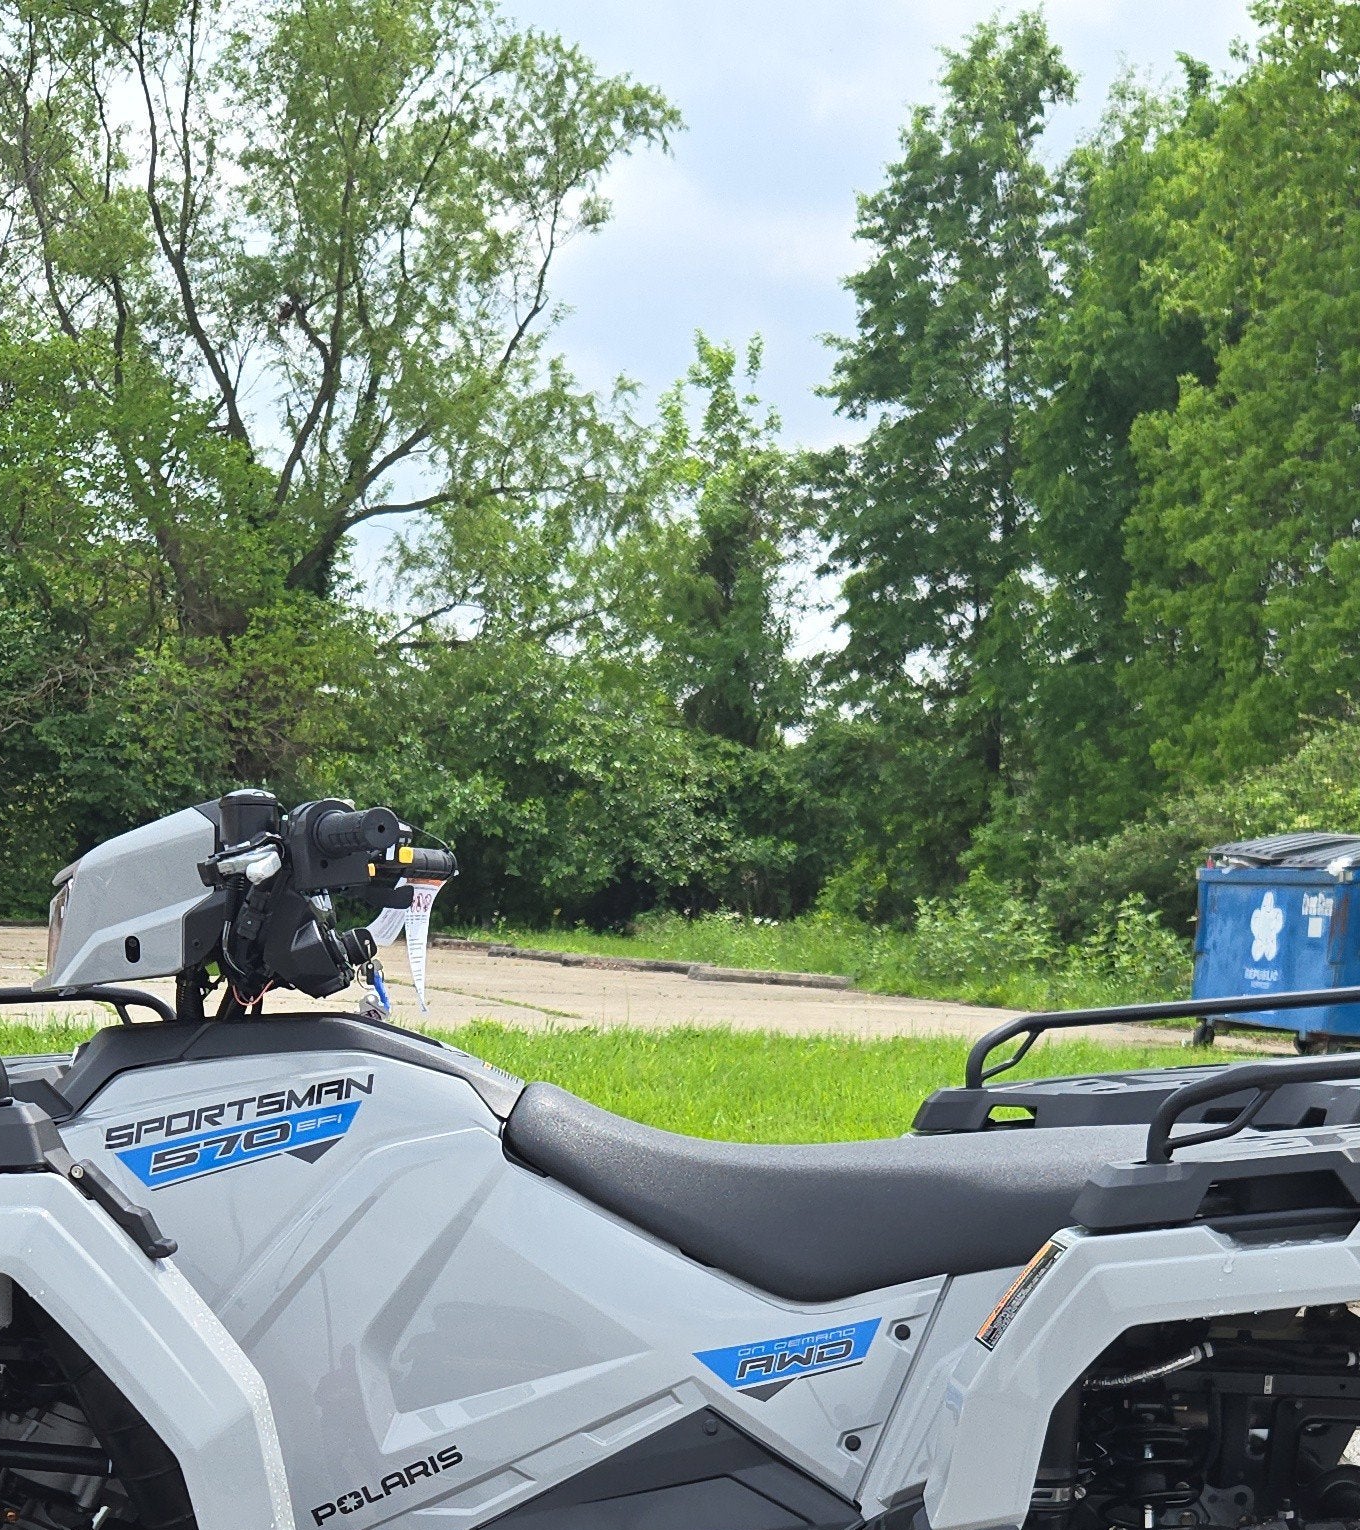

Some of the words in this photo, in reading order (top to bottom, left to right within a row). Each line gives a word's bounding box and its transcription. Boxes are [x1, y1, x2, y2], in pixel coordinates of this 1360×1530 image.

[104, 1073, 375, 1150] SPORTSMAN
[148, 1120, 293, 1176] 570
[295, 1112, 342, 1134] EFI
[735, 1338, 855, 1381] AWD
[773, 1327, 856, 1351] DEMAND
[310, 1444, 464, 1528] POLARIS
